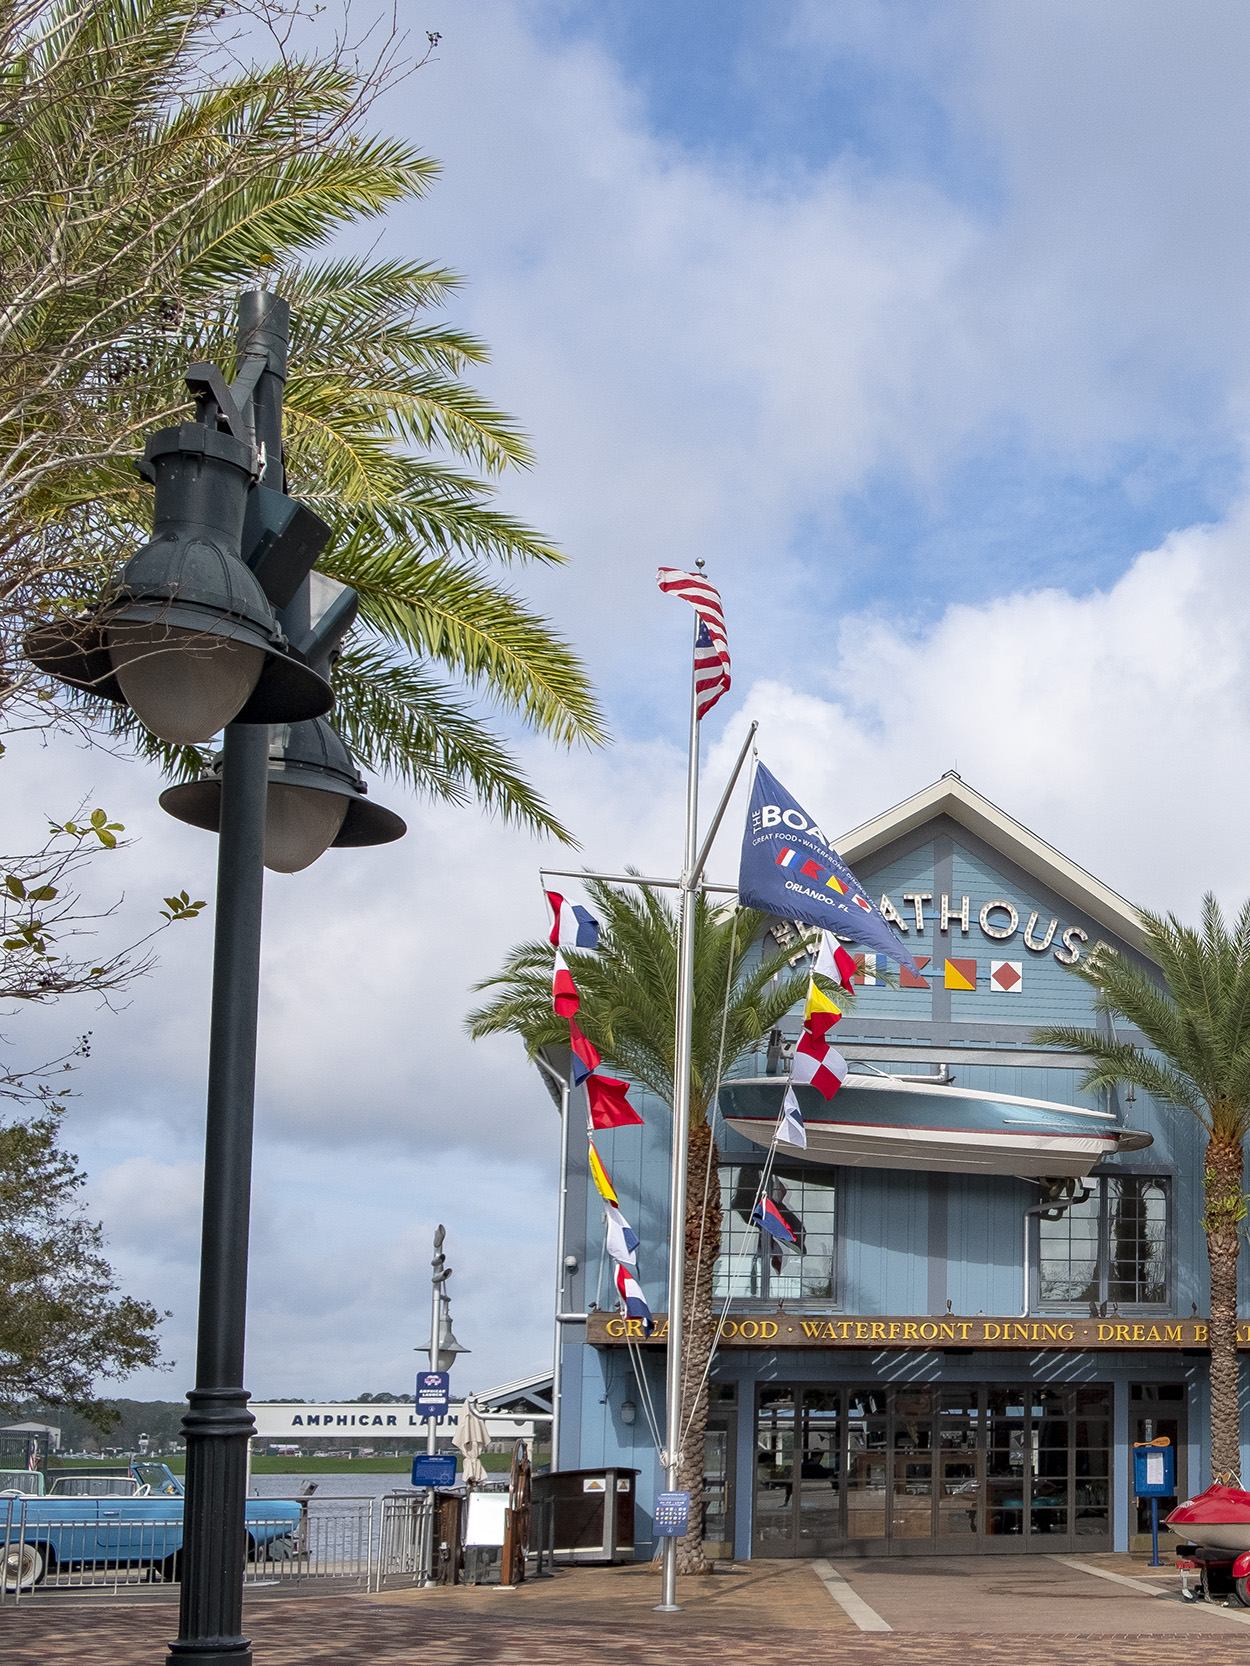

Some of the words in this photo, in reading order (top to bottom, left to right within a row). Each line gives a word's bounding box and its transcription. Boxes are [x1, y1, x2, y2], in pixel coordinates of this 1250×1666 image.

[752, 809, 762, 835] THE
[762, 805, 834, 852] BOA
[752, 833, 773, 847] GREAT
[775, 833, 798, 843] FOOD
[802, 838, 847, 873] WATERFRONT
[785, 880, 836, 906] ORLANDO,
[837, 903, 850, 913] FL
[711, 1320, 778, 1340] OOD
[800, 1321, 973, 1340] WATERFRONT
[983, 1322, 1074, 1342] DINING
[1097, 1324, 1184, 1342] DREAM
[291, 1415, 397, 1426] AMPHICAR
